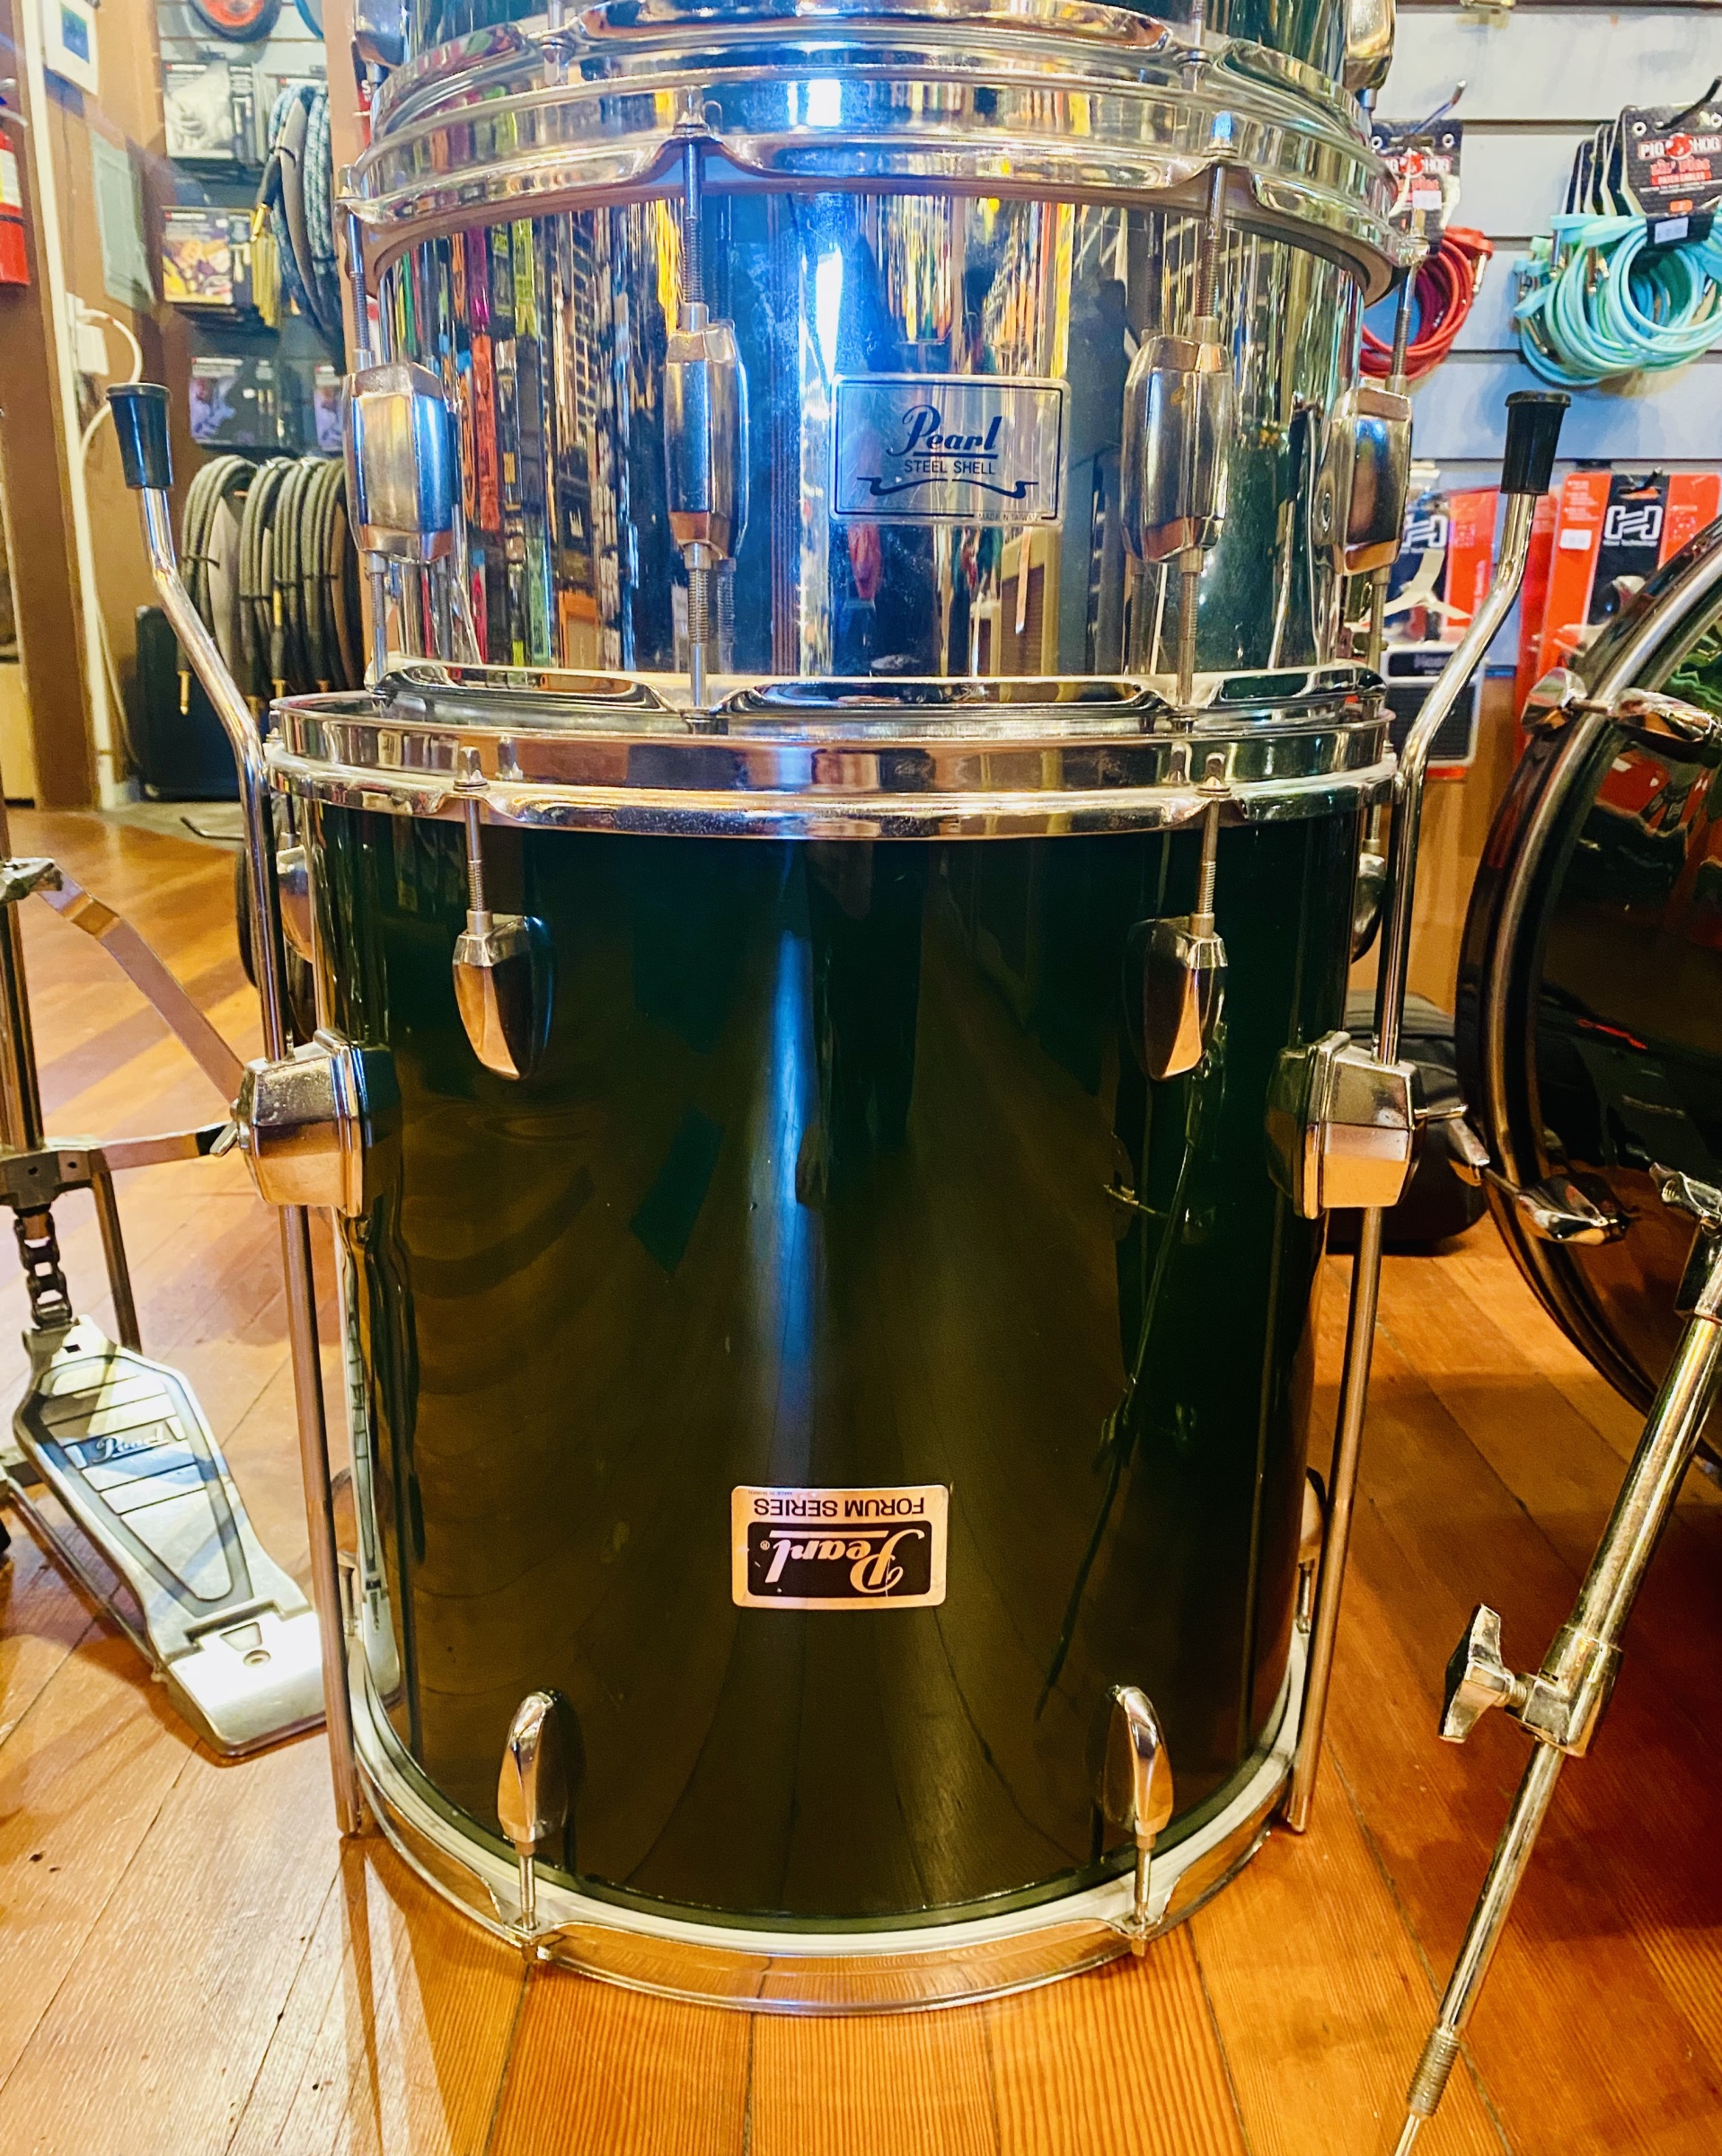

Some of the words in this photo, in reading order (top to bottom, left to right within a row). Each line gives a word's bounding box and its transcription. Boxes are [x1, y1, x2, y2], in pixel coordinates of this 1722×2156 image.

[1640, 142, 1665, 159] PIG
[1691, 137, 1720, 154] HOG
[1423, 158, 1451, 173] HOG
[886, 404, 1002, 456] Pearl
[904, 459, 948, 473] STEEL
[953, 460, 995, 475] SHELL
[754, 1498, 838, 1517] SERIES
[844, 1497, 924, 1516] FORUM
